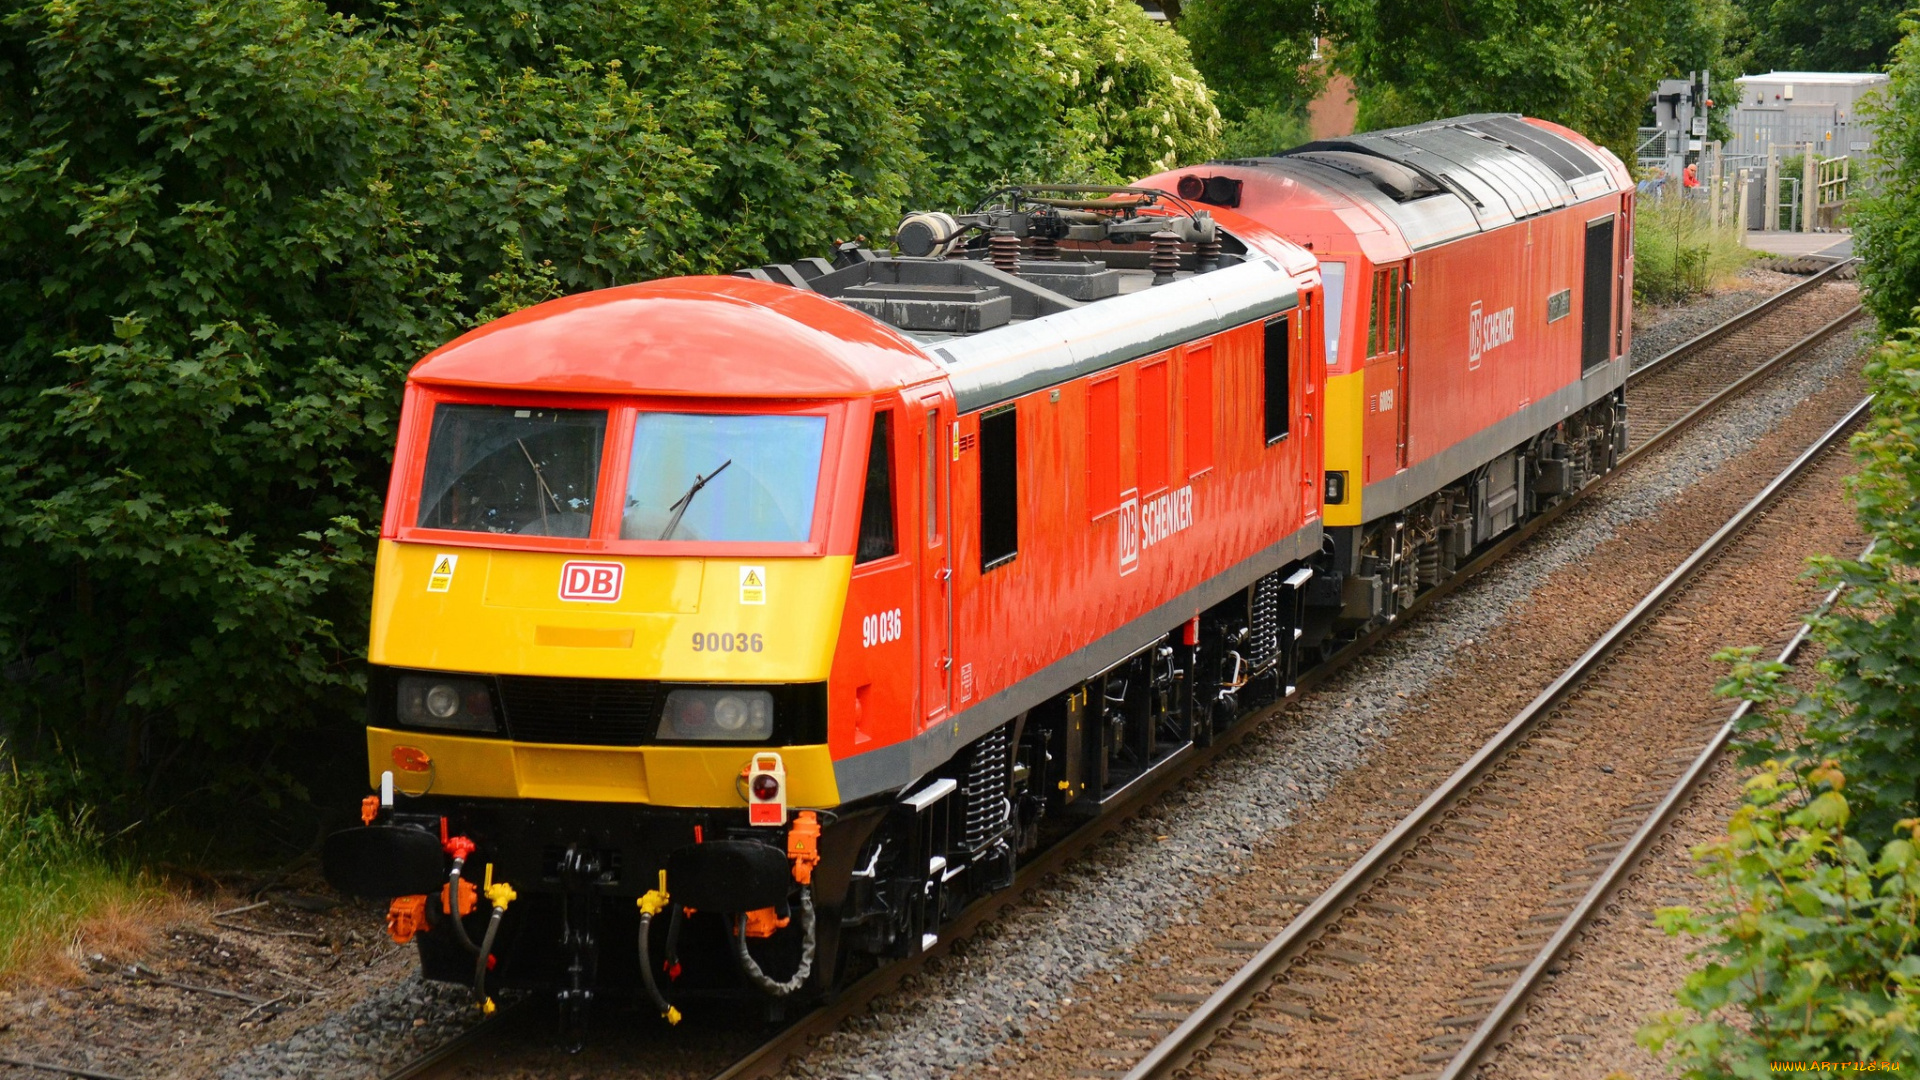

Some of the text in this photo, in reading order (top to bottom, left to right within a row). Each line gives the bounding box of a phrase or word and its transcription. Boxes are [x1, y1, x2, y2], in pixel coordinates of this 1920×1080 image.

[1483, 306, 1514, 353] SCHENKER
[1142, 485, 1193, 549] SCHENKER
[566, 566, 615, 597] DB
[692, 632, 763, 653] 90036
